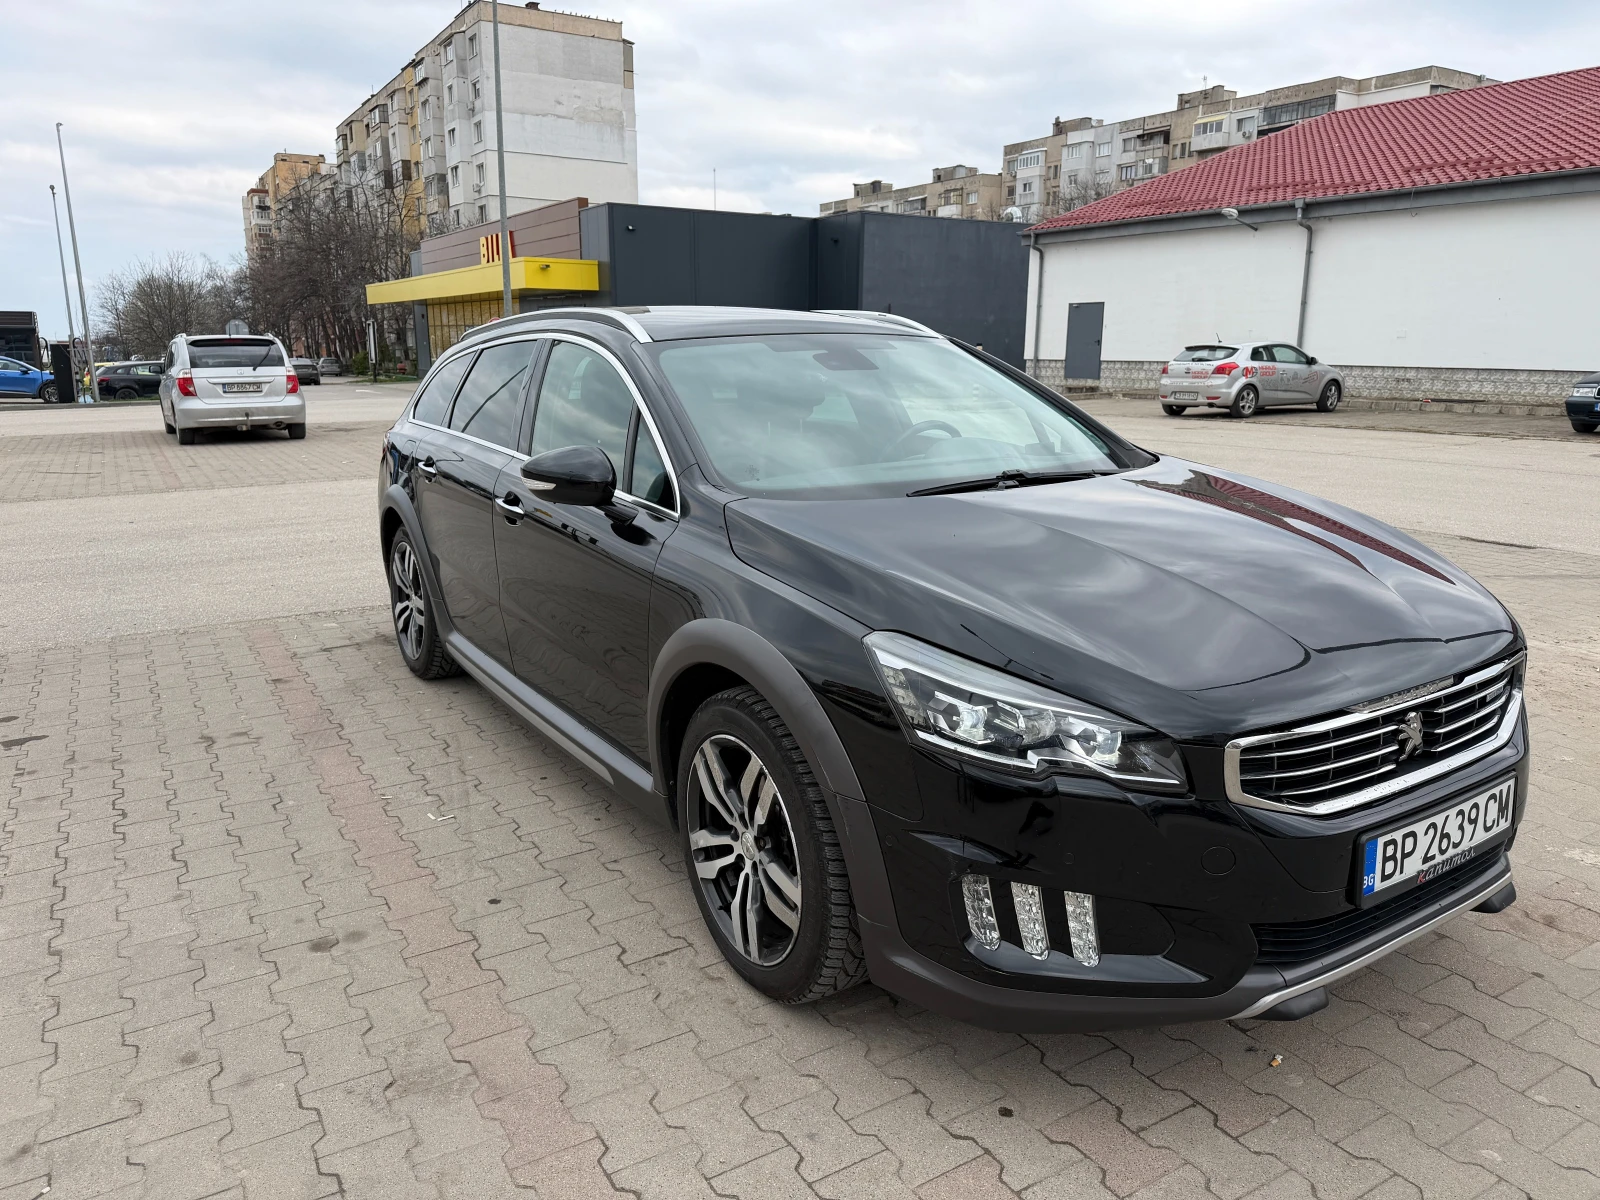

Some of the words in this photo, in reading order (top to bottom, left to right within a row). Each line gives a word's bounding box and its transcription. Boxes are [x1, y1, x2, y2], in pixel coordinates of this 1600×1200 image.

[480, 230, 515, 264] BILL
[1380, 830, 1418, 883] BP
[1421, 801, 1480, 866] 2639
[1482, 784, 1512, 833] CM
